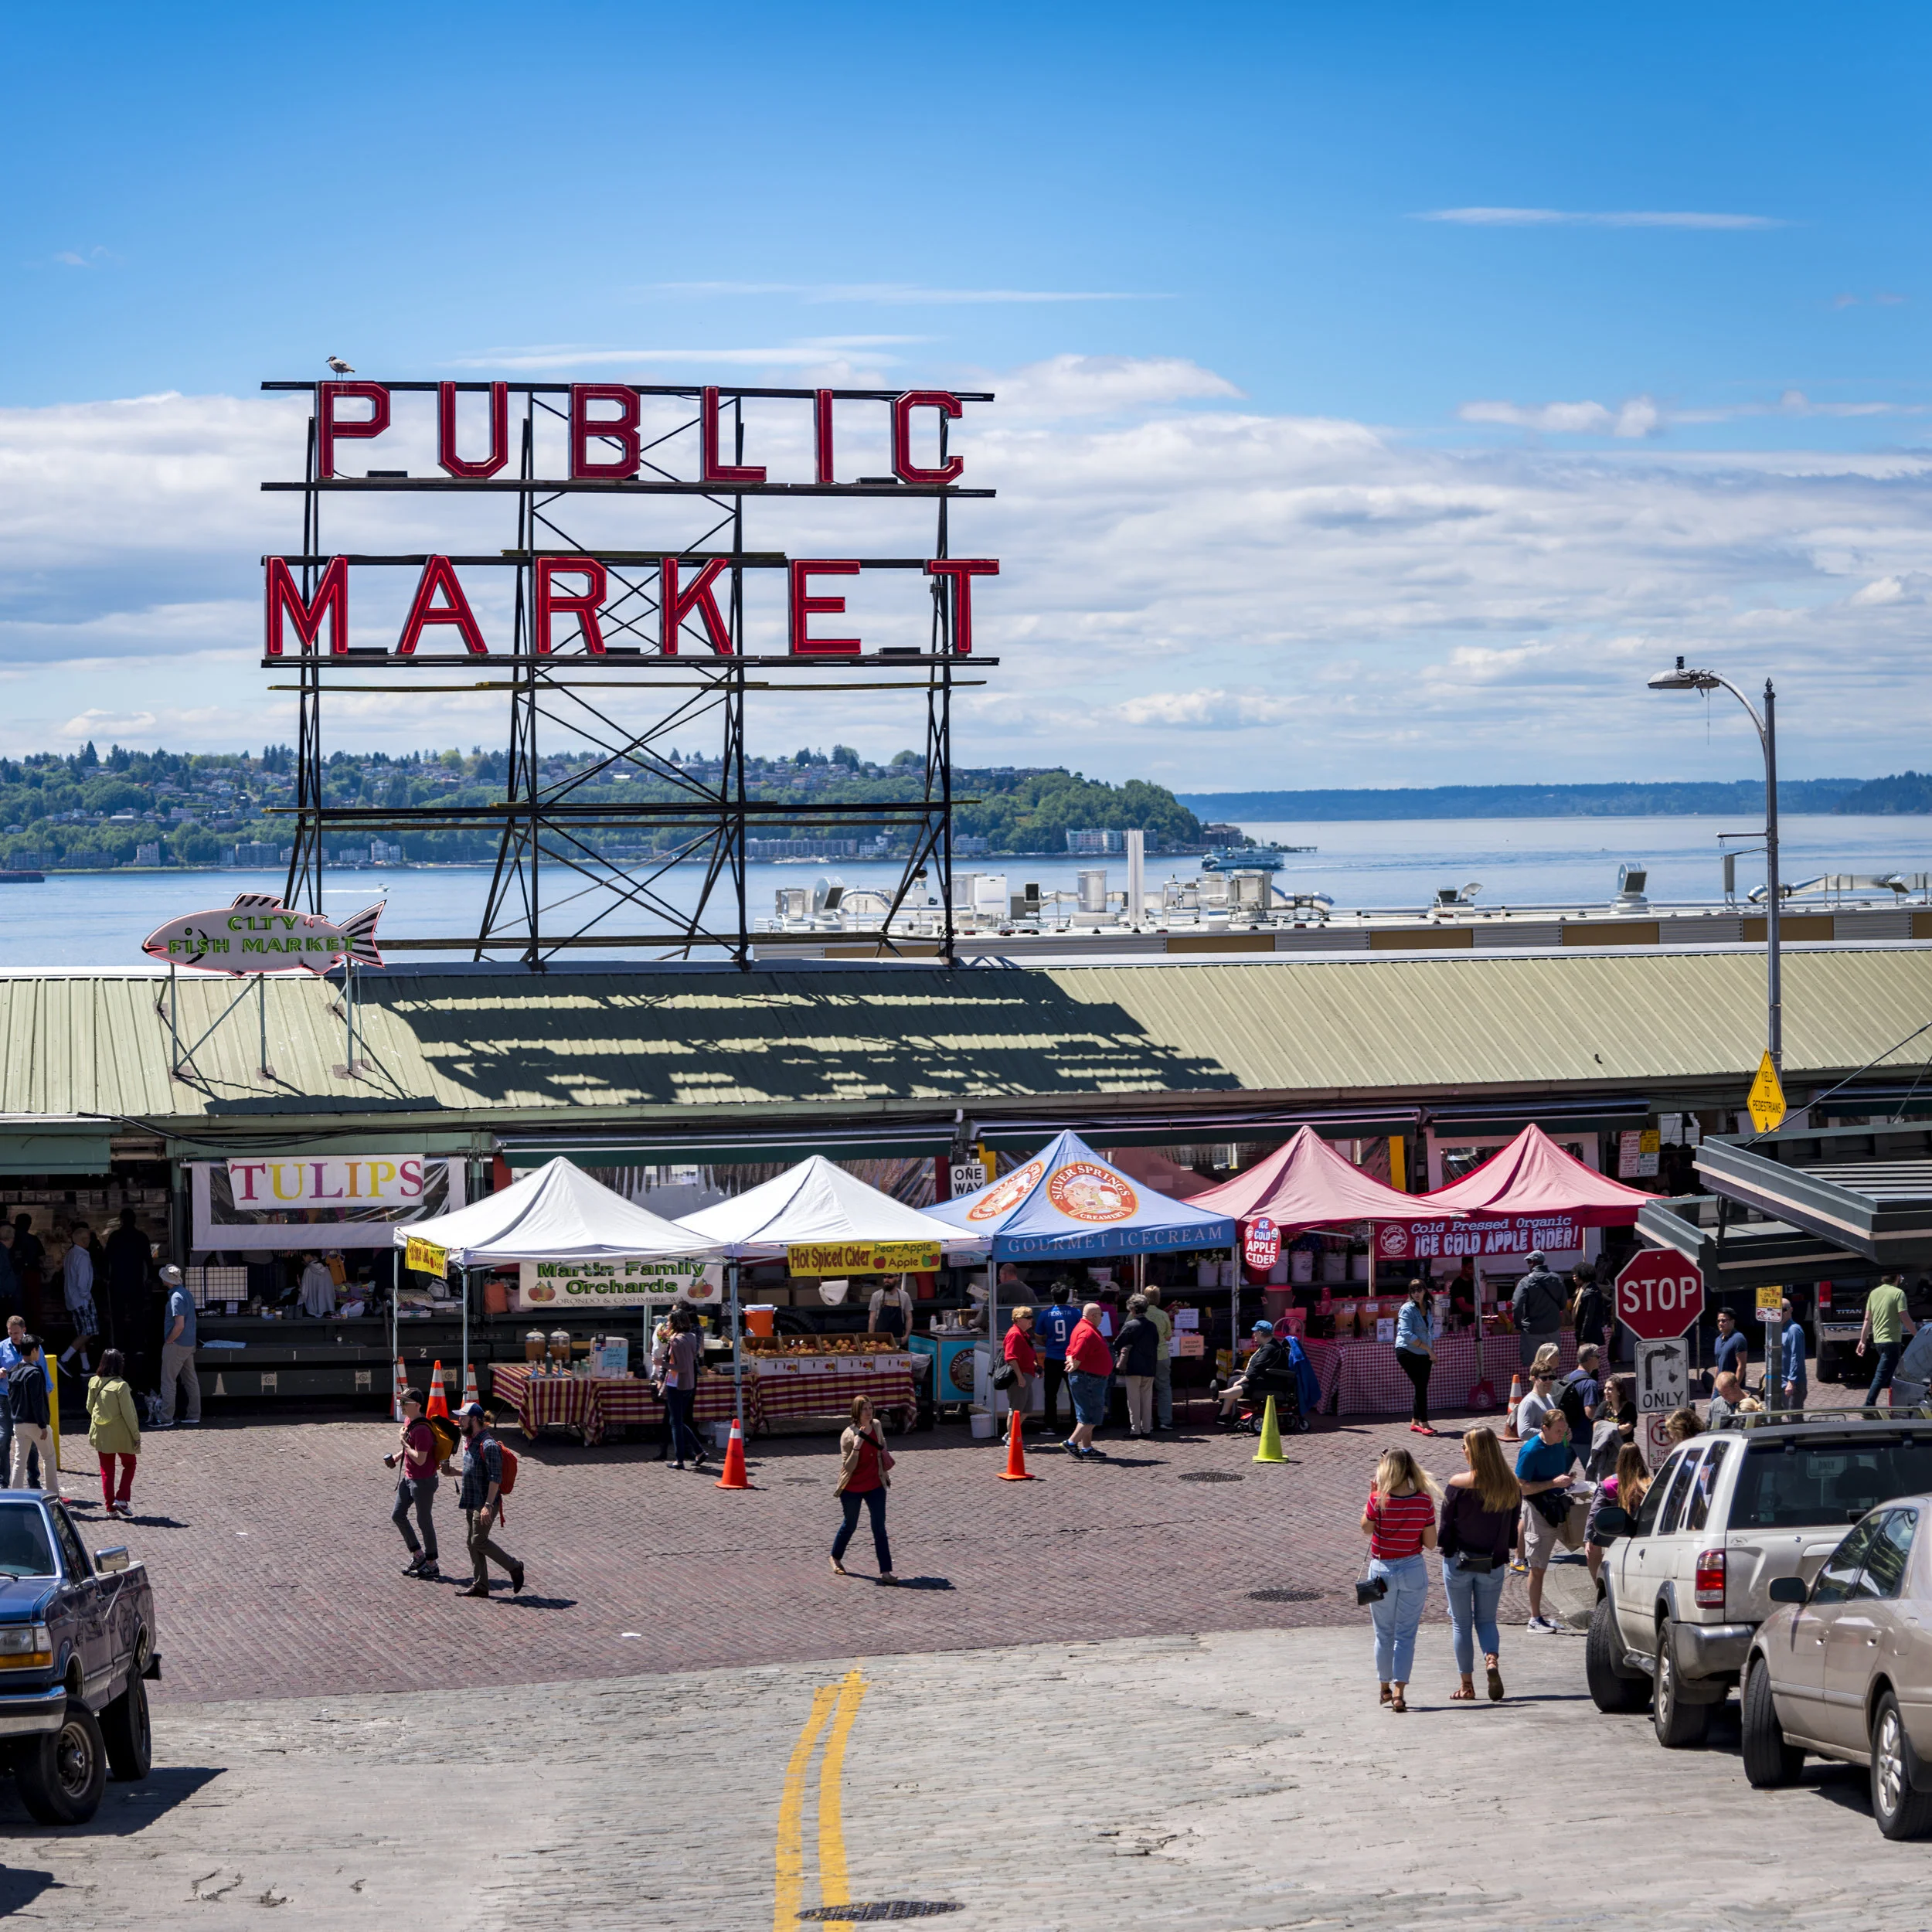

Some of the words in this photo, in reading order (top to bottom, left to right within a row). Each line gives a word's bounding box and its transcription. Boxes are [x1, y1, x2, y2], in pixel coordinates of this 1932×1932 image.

[316, 380, 964, 484] PUBLIC
[265, 556, 999, 655] MARKET
[227, 914, 298, 931] CITY
[168, 937, 230, 954] FISH
[243, 937, 356, 953] MARKET
[1762, 1071, 1773, 1083] YIELD
[1764, 1086, 1770, 1097] TO
[1753, 1100, 1781, 1114] PEDESTRIANS
[230, 1160, 424, 1200] TULIPS
[954, 1168, 982, 1180] ONE
[954, 1182, 983, 1194] WAY
[1052, 1168, 1077, 1200] SILVER
[1077, 1165, 1131, 1196] SPRINGS
[1080, 1211, 1126, 1220] CREAMERY
[1259, 1219, 1269, 1229] ICE
[1411, 1222, 1444, 1234] Cold
[1451, 1219, 1509, 1232] Pressed
[1516, 1216, 1572, 1230] Organic
[1008, 1233, 1109, 1253] GOURMET
[1120, 1226, 1223, 1246] ICECREAM
[1254, 1228, 1270, 1241] COLD
[1414, 1234, 1439, 1257] ICE
[1444, 1232, 1481, 1256] COLD
[1485, 1230, 1528, 1253] APPLE
[1532, 1226, 1579, 1250] CIDER!
[874, 1243, 932, 1253] Pear-Apple
[1247, 1240, 1276, 1253] APPLE
[791, 1247, 809, 1269] Hot
[811, 1247, 843, 1272] Spiced
[845, 1246, 871, 1267] Cider
[888, 1258, 918, 1269] Apple
[1246, 1252, 1276, 1264] CIDER
[537, 1262, 614, 1277] Martin
[625, 1261, 706, 1277] Family
[566, 1279, 679, 1294] Orchards
[1784, 1284, 1793, 1293] 13
[1623, 1277, 1697, 1313] STOP
[1054, 1320, 1066, 1342] 9
[420, 1348, 427, 1358] 2
[952, 1352, 968, 1372] SILVER
[1643, 1391, 1684, 1408] ONLY
